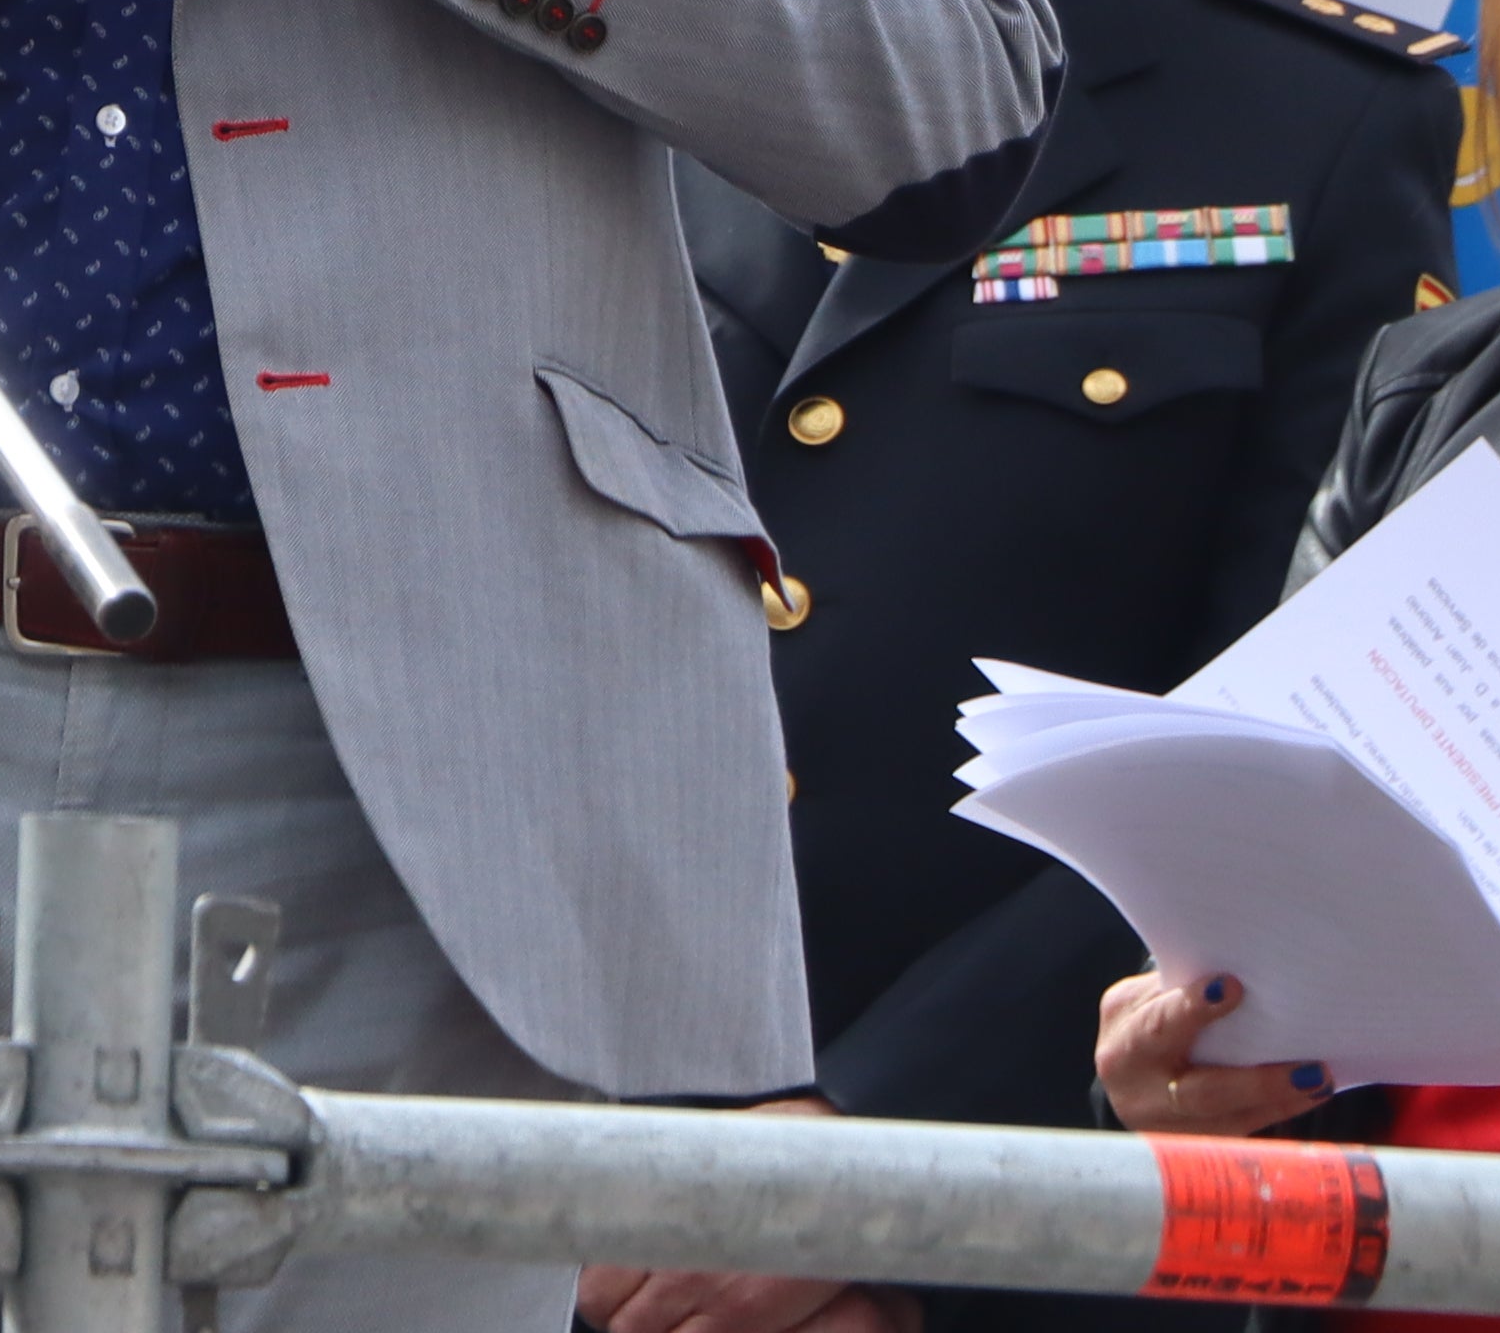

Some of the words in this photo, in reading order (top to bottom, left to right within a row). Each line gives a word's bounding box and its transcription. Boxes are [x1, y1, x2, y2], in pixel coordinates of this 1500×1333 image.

[1400, 592, 1447, 644] Antonio
[1421, 575, 1474, 634] Servicios
[1441, 642, 1473, 676] Juan
[1466, 630, 1489, 654] de
[1362, 647, 1437, 731] DIPUTACIÓN
[1432, 671, 1455, 697] sus
[1305, 673, 1365, 740] Presidente
[1455, 699, 1479, 725] por
